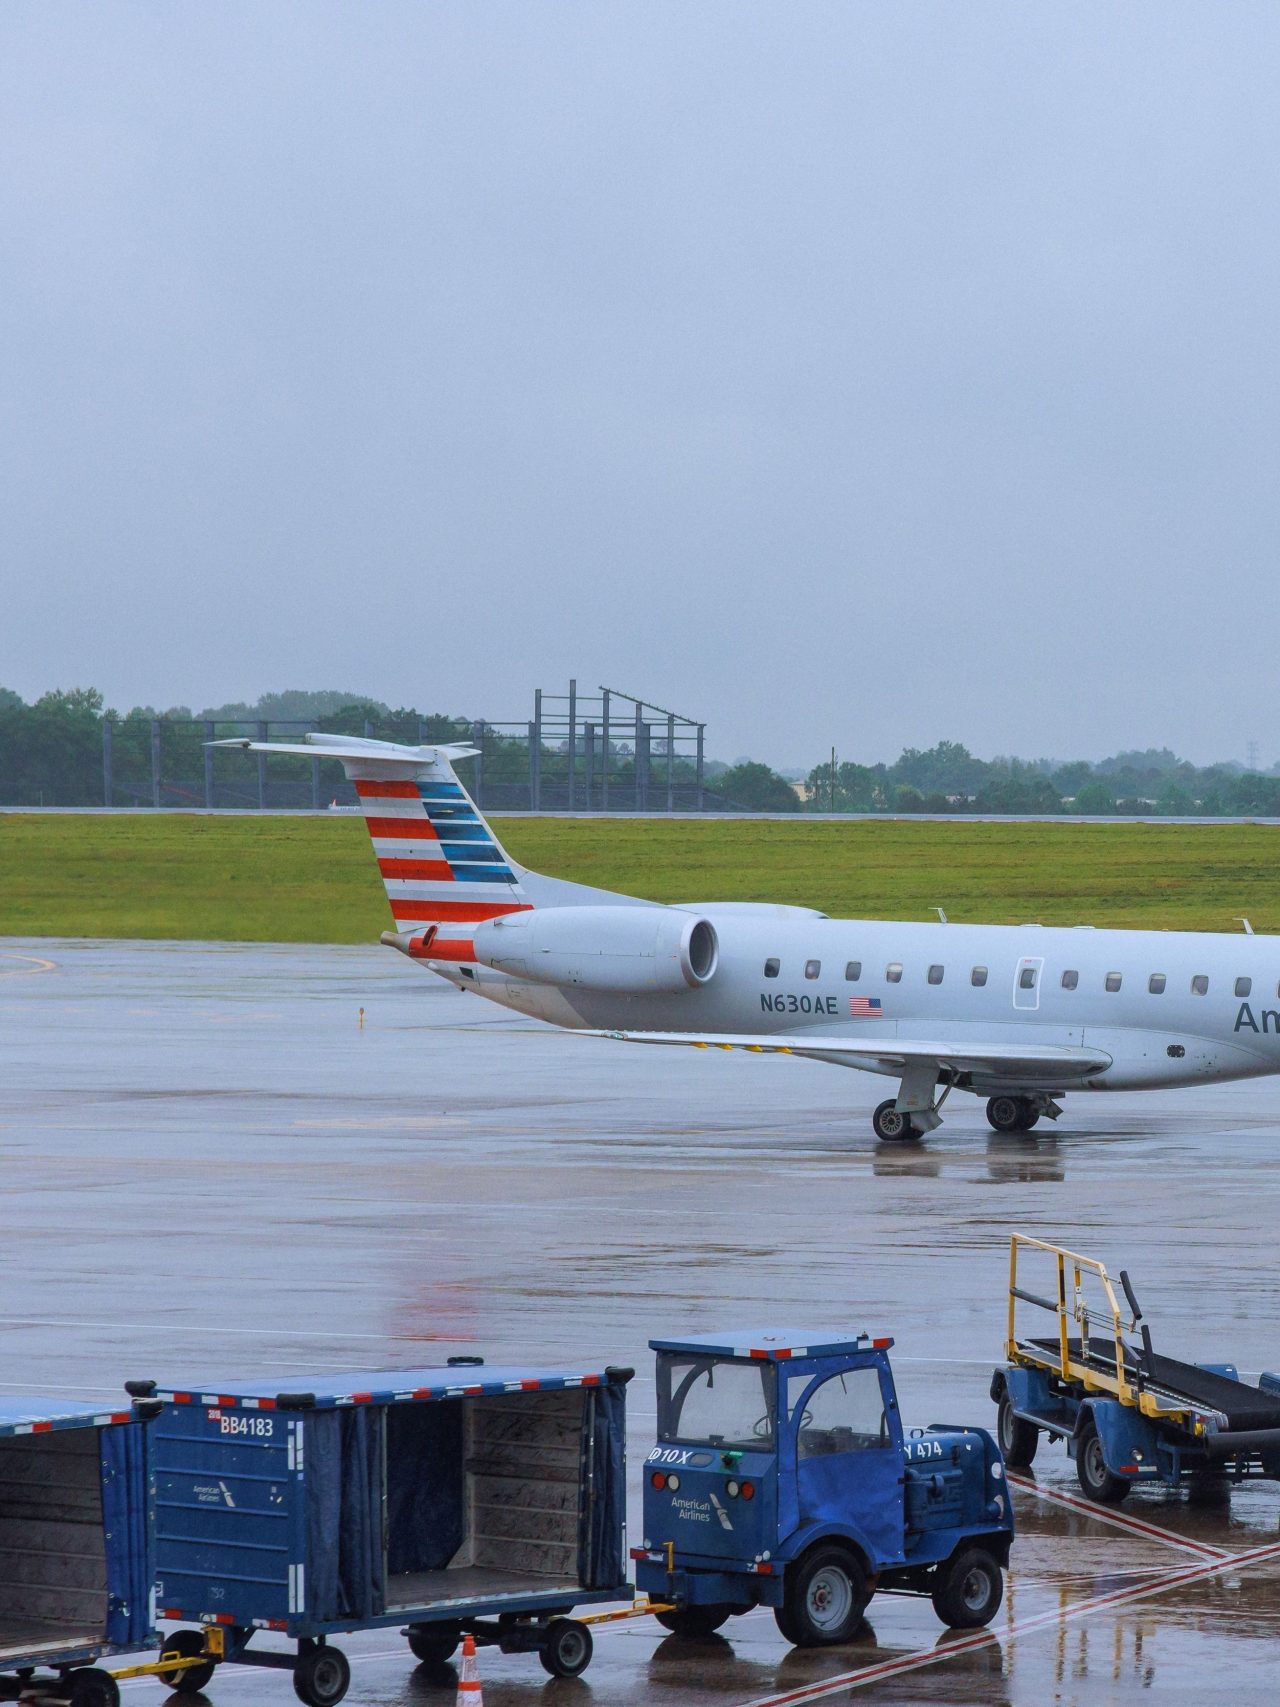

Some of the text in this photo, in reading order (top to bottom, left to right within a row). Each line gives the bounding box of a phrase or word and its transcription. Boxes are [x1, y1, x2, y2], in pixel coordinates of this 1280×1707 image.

[760, 993, 839, 1015] N630AE
[220, 1415, 274, 1437] BB4183
[917, 1441, 943, 1458] 474
[671, 1497, 711, 1511] American
[678, 1509, 710, 1522] Airlines
